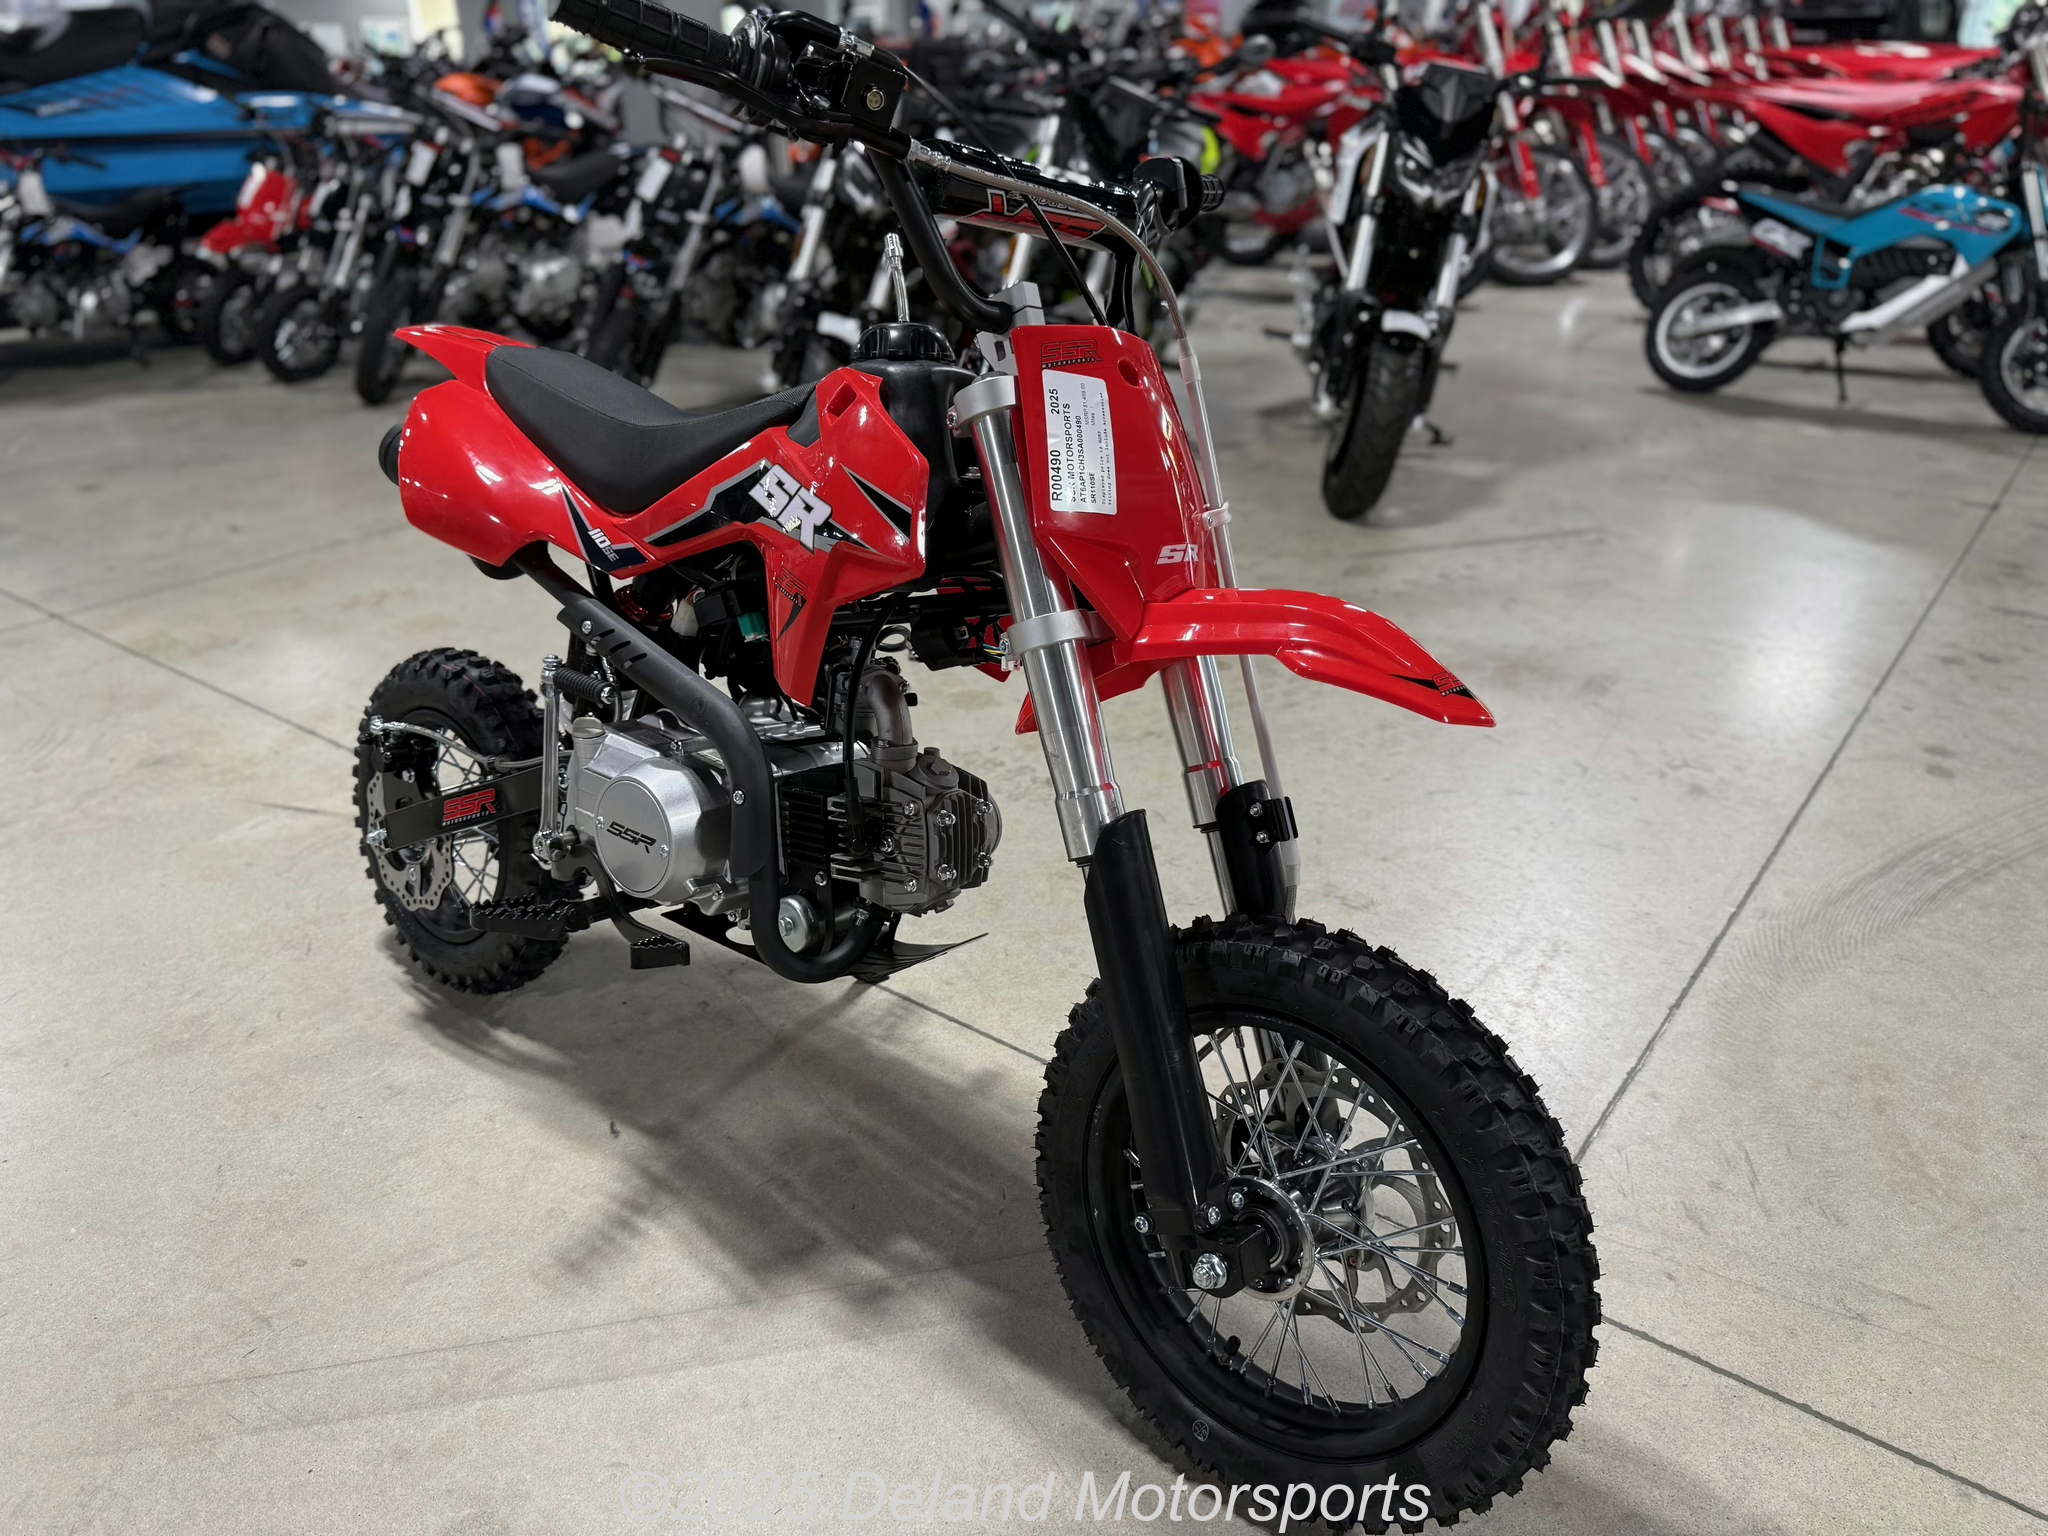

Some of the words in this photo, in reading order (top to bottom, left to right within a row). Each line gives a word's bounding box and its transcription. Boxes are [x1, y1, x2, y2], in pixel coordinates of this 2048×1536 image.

[1041, 340, 1103, 364] SSR
[1042, 357, 1096, 369] MOTORSPORTS
[1048, 388, 1060, 415] 2025
[1062, 403, 1075, 480] MOTORSPORTS
[1049, 449, 1063, 501] R00490
[1088, 472, 1097, 504] SR110SE
[748, 464, 833, 552] SR
[1157, 544, 1199, 565] SR
[1432, 671, 1464, 693] SS
[443, 788, 497, 822] SSR
[606, 821, 657, 854] SSR
